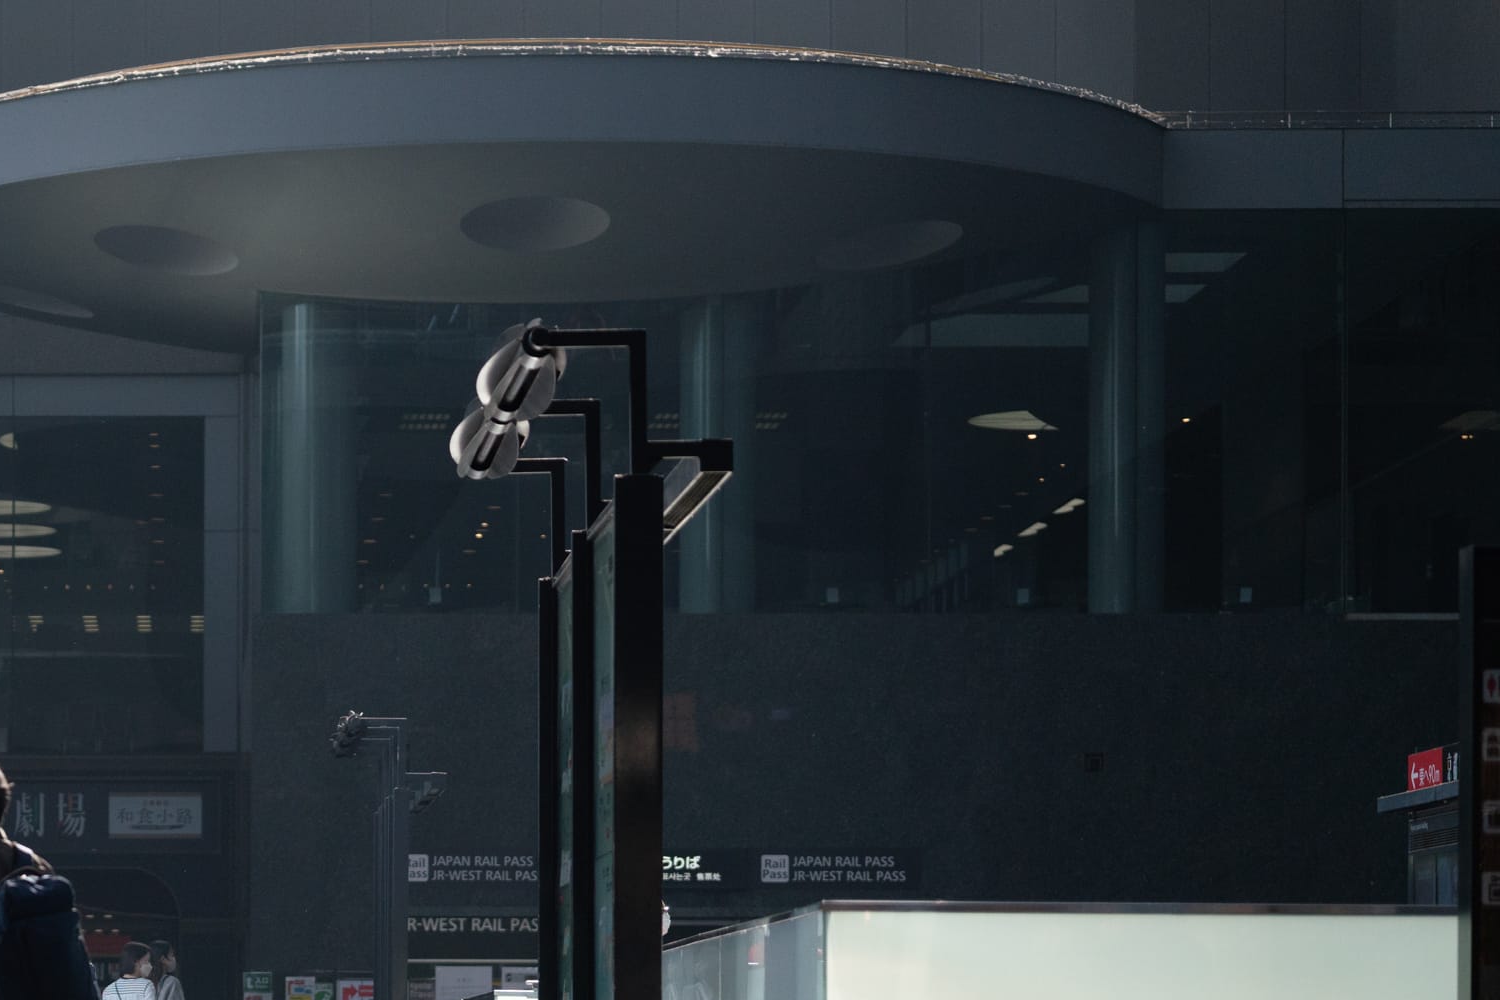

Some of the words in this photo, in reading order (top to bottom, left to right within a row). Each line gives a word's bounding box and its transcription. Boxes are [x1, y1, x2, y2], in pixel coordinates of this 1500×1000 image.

[14, 792, 87, 838] 劇場
[409, 857, 426, 868] ail
[432, 855, 471, 867] JAPAN
[474, 855, 500, 867] RAIL
[504, 855, 534, 867] PASS
[764, 858, 787, 869] Rail
[792, 856, 833, 868] JAPAN
[835, 856, 862, 868] RAIL
[865, 856, 896, 868] PASS
[409, 870, 428, 879] ass
[431, 870, 483, 881] JR-WEST
[486, 870, 512, 881] RAIL
[763, 869, 789, 880] Pass
[792, 870, 845, 882] JR-WEST
[847, 870, 874, 882] RAIL
[877, 870, 907, 882] PASS
[471, 917, 506, 932] RAIL
